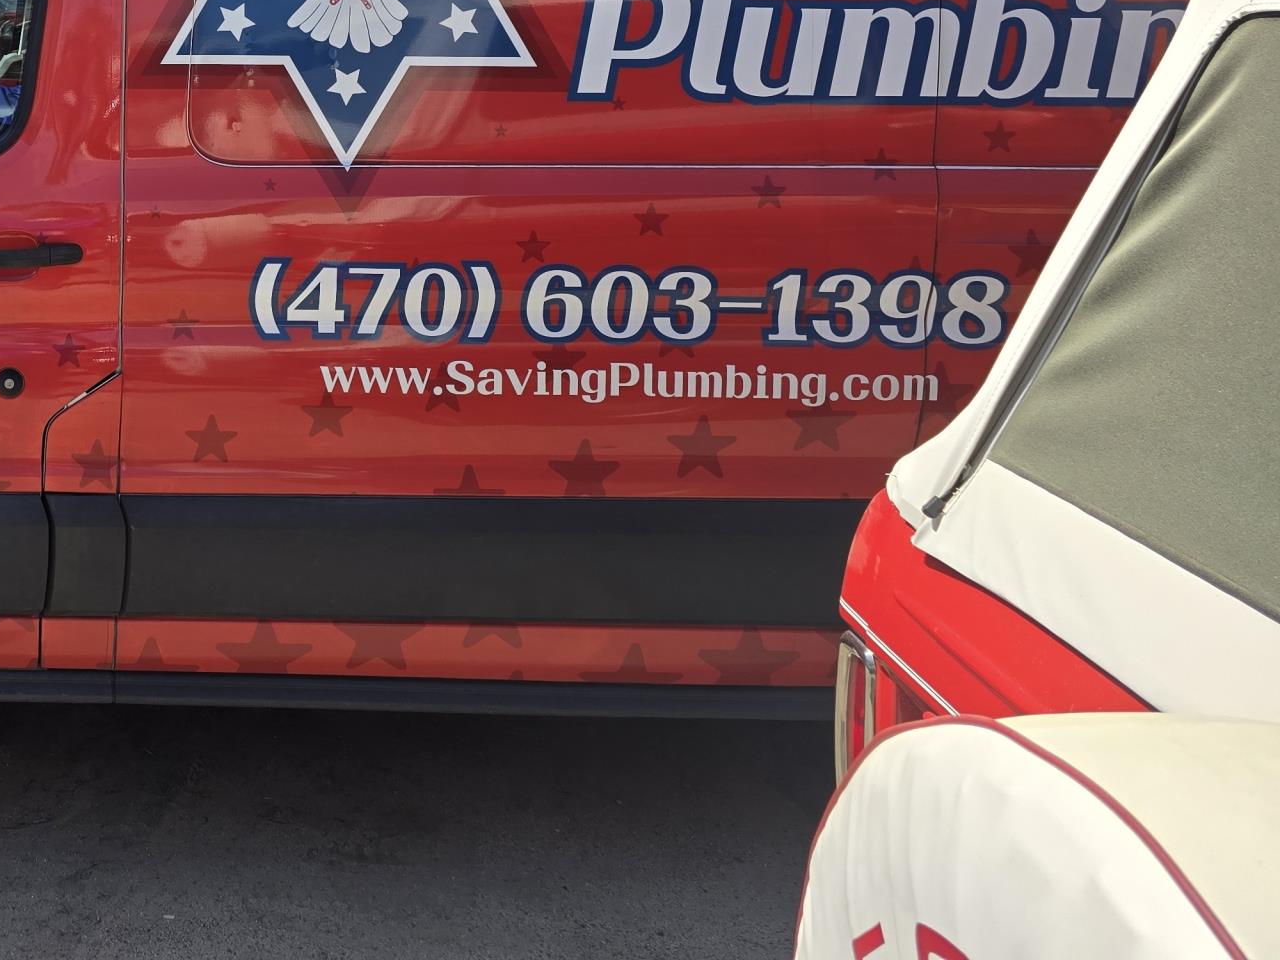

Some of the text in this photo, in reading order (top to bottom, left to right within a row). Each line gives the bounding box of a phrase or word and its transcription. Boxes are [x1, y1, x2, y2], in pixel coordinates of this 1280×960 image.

[253, 262, 1006, 346] (470) 603-1398
[319, 360, 939, 408] www.SavingPlumbing.com
